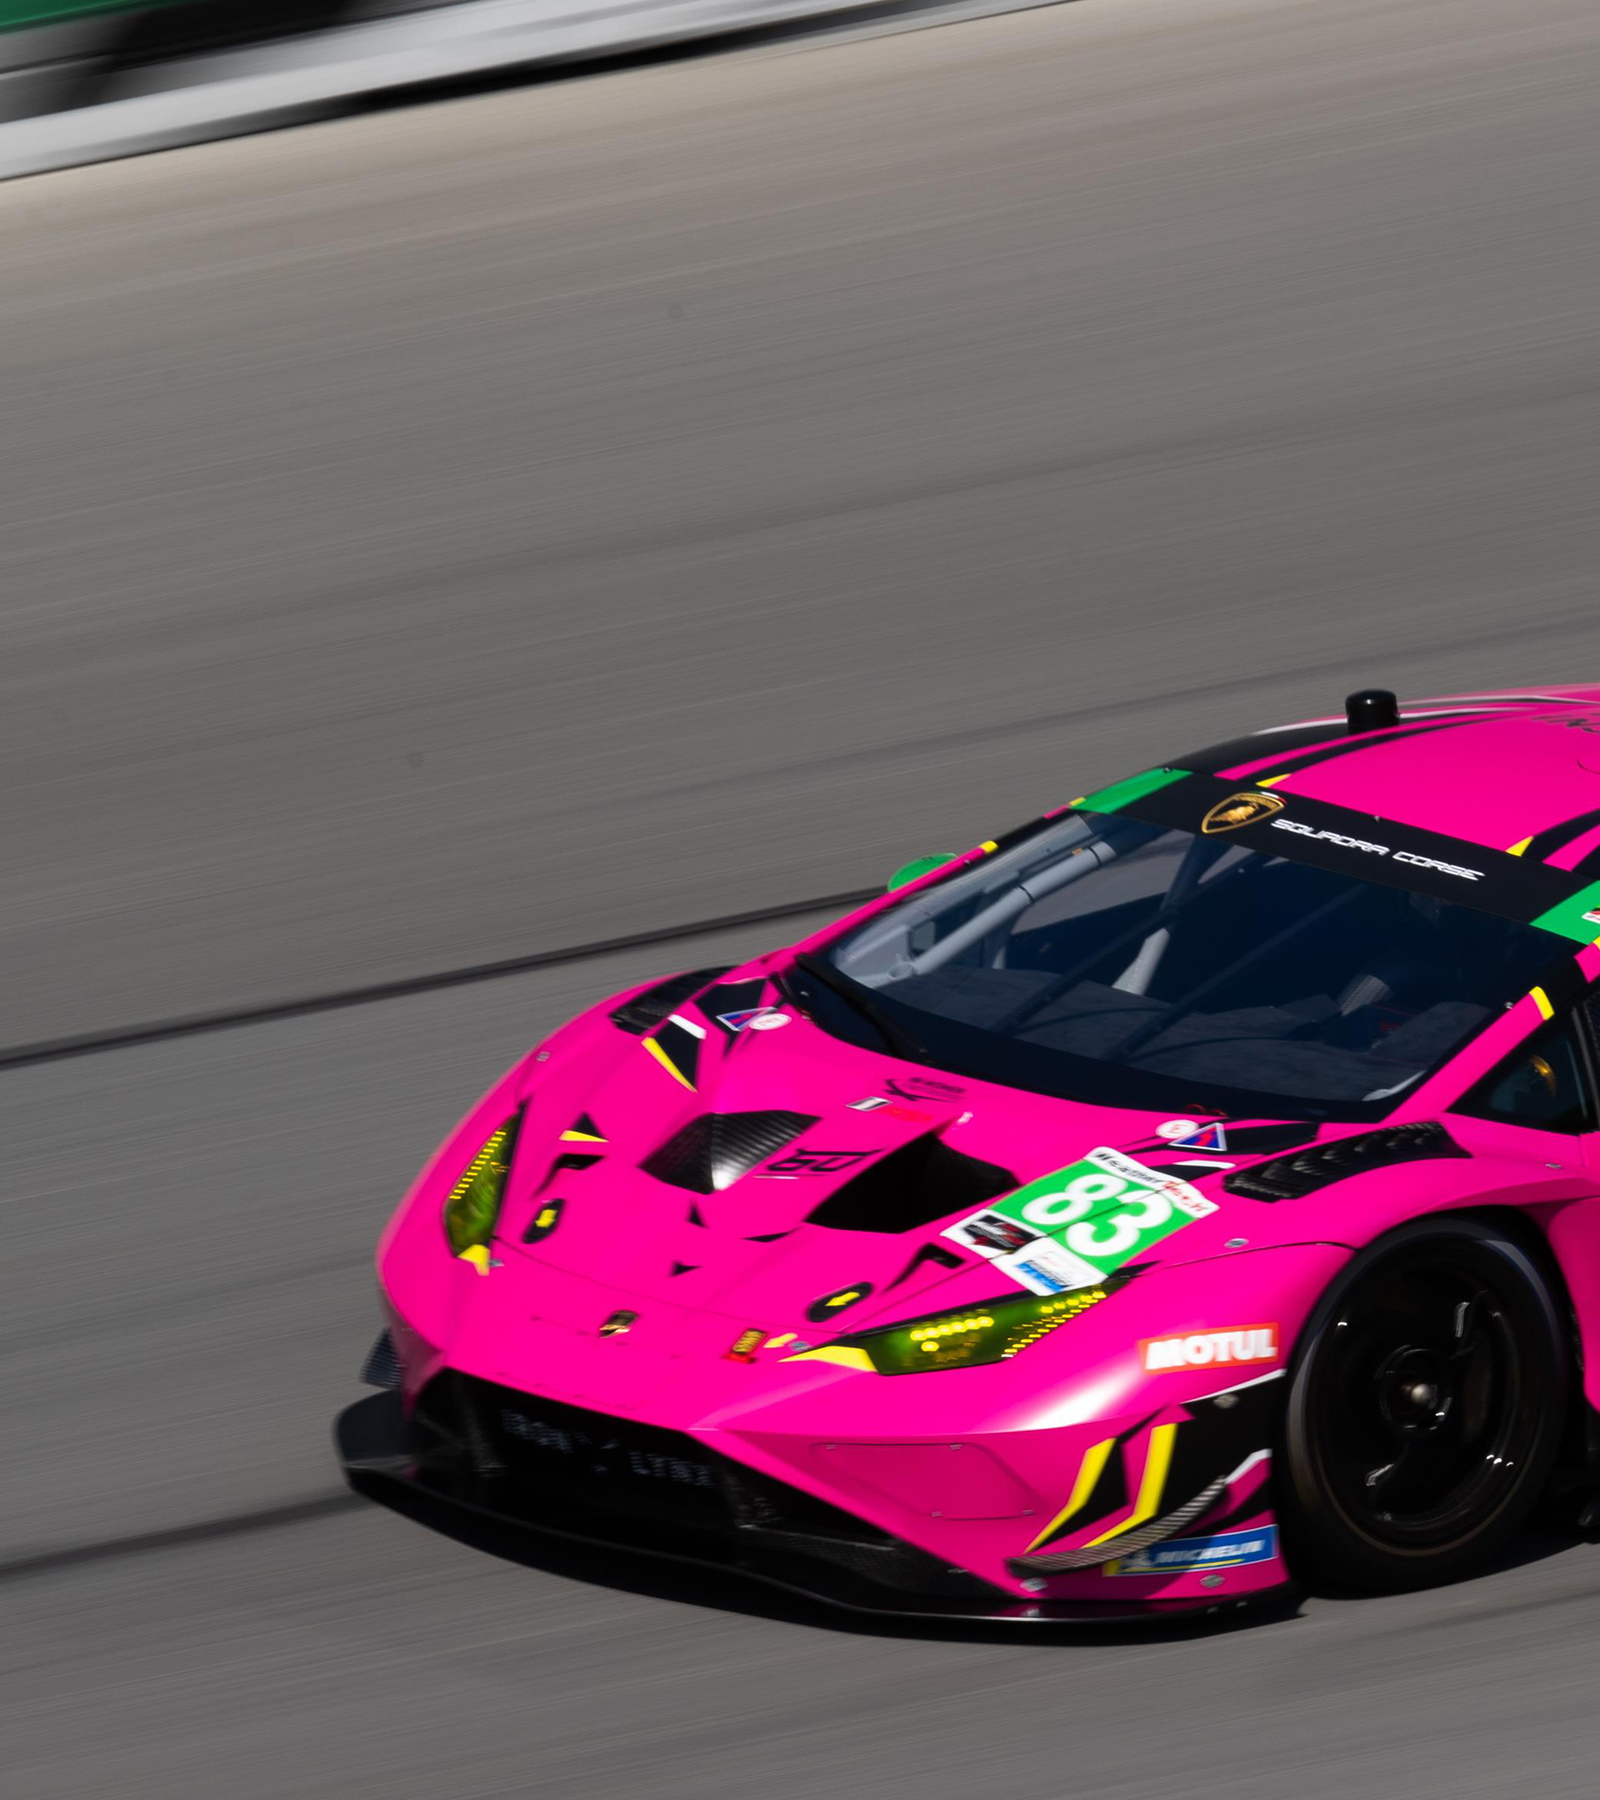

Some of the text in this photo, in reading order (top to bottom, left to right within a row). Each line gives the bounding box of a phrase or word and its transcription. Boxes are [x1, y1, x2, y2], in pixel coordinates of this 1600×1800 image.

[1270, 818, 1486, 881] SQUADRA CORSE
[1022, 1173, 1173, 1257] 83
[1145, 1328, 1278, 1370] MOTUL
[1154, 1539, 1266, 1564] MICHELIN
